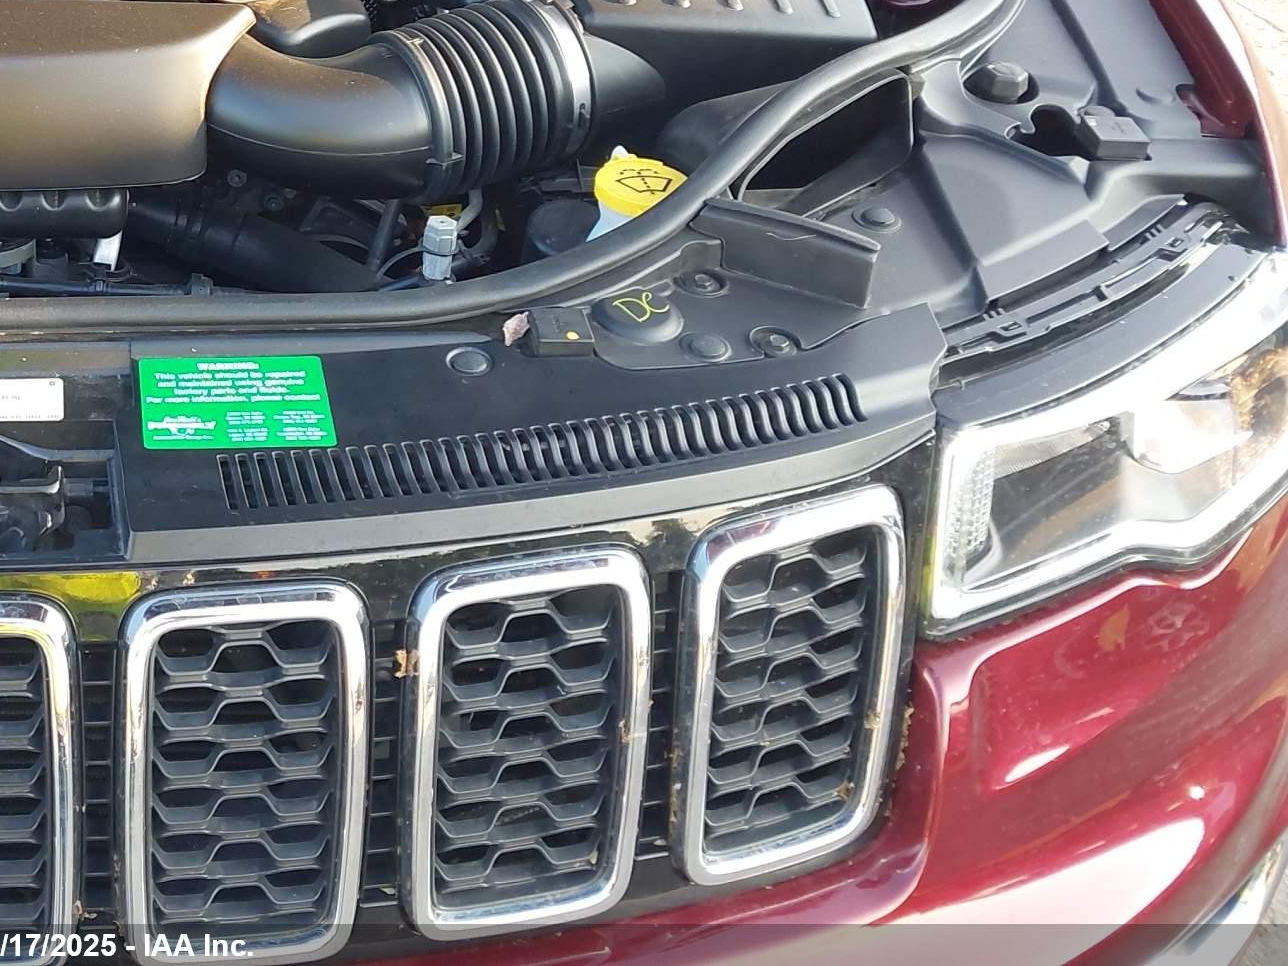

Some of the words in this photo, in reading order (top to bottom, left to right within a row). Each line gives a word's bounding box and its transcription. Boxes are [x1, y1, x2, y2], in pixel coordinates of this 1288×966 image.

[154, 372, 176, 380] This
[264, 370, 306, 379] repaired
[157, 380, 177, 388] and
[264, 379, 305, 387] genuine
